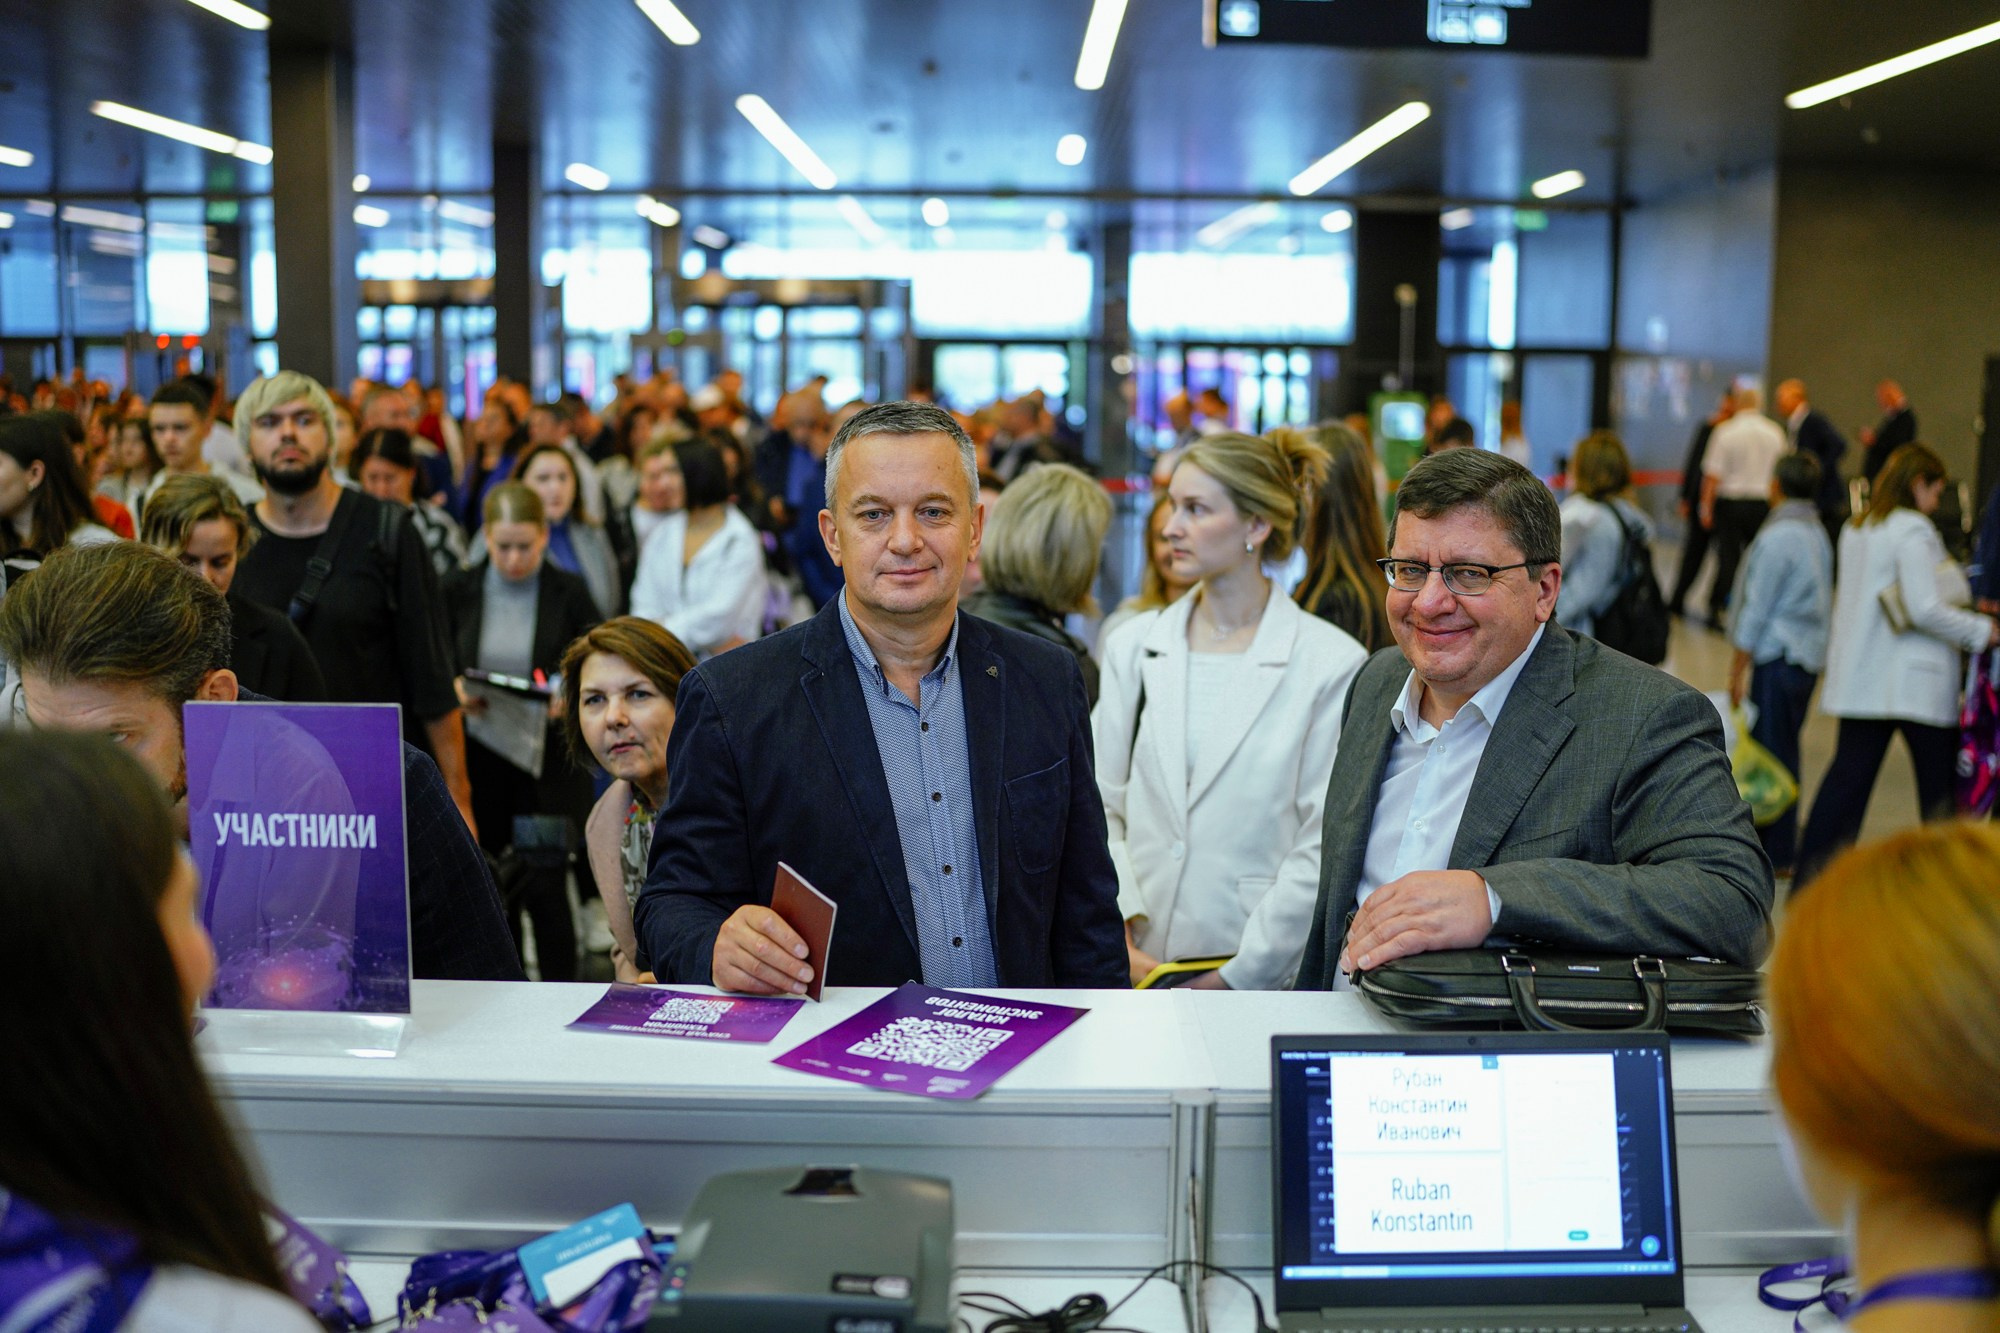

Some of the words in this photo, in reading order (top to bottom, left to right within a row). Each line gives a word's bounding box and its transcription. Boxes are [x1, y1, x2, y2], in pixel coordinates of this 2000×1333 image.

[213, 812, 377, 848] УЧАСТНИКИ
[924, 996, 1044, 1020] ЭКСПОНЕНТОВ
[932, 1007, 1010, 1024] КАТАЛОГ
[643, 1020, 708, 1031] ТЕХНОПРОМ
[1392, 1066, 1442, 1091] Рубан
[1368, 1095, 1468, 1114] Константин
[1377, 1121, 1461, 1141] Иванович
[1392, 1177, 1450, 1200] Ruban
[1371, 1209, 1472, 1232] Konstantin
